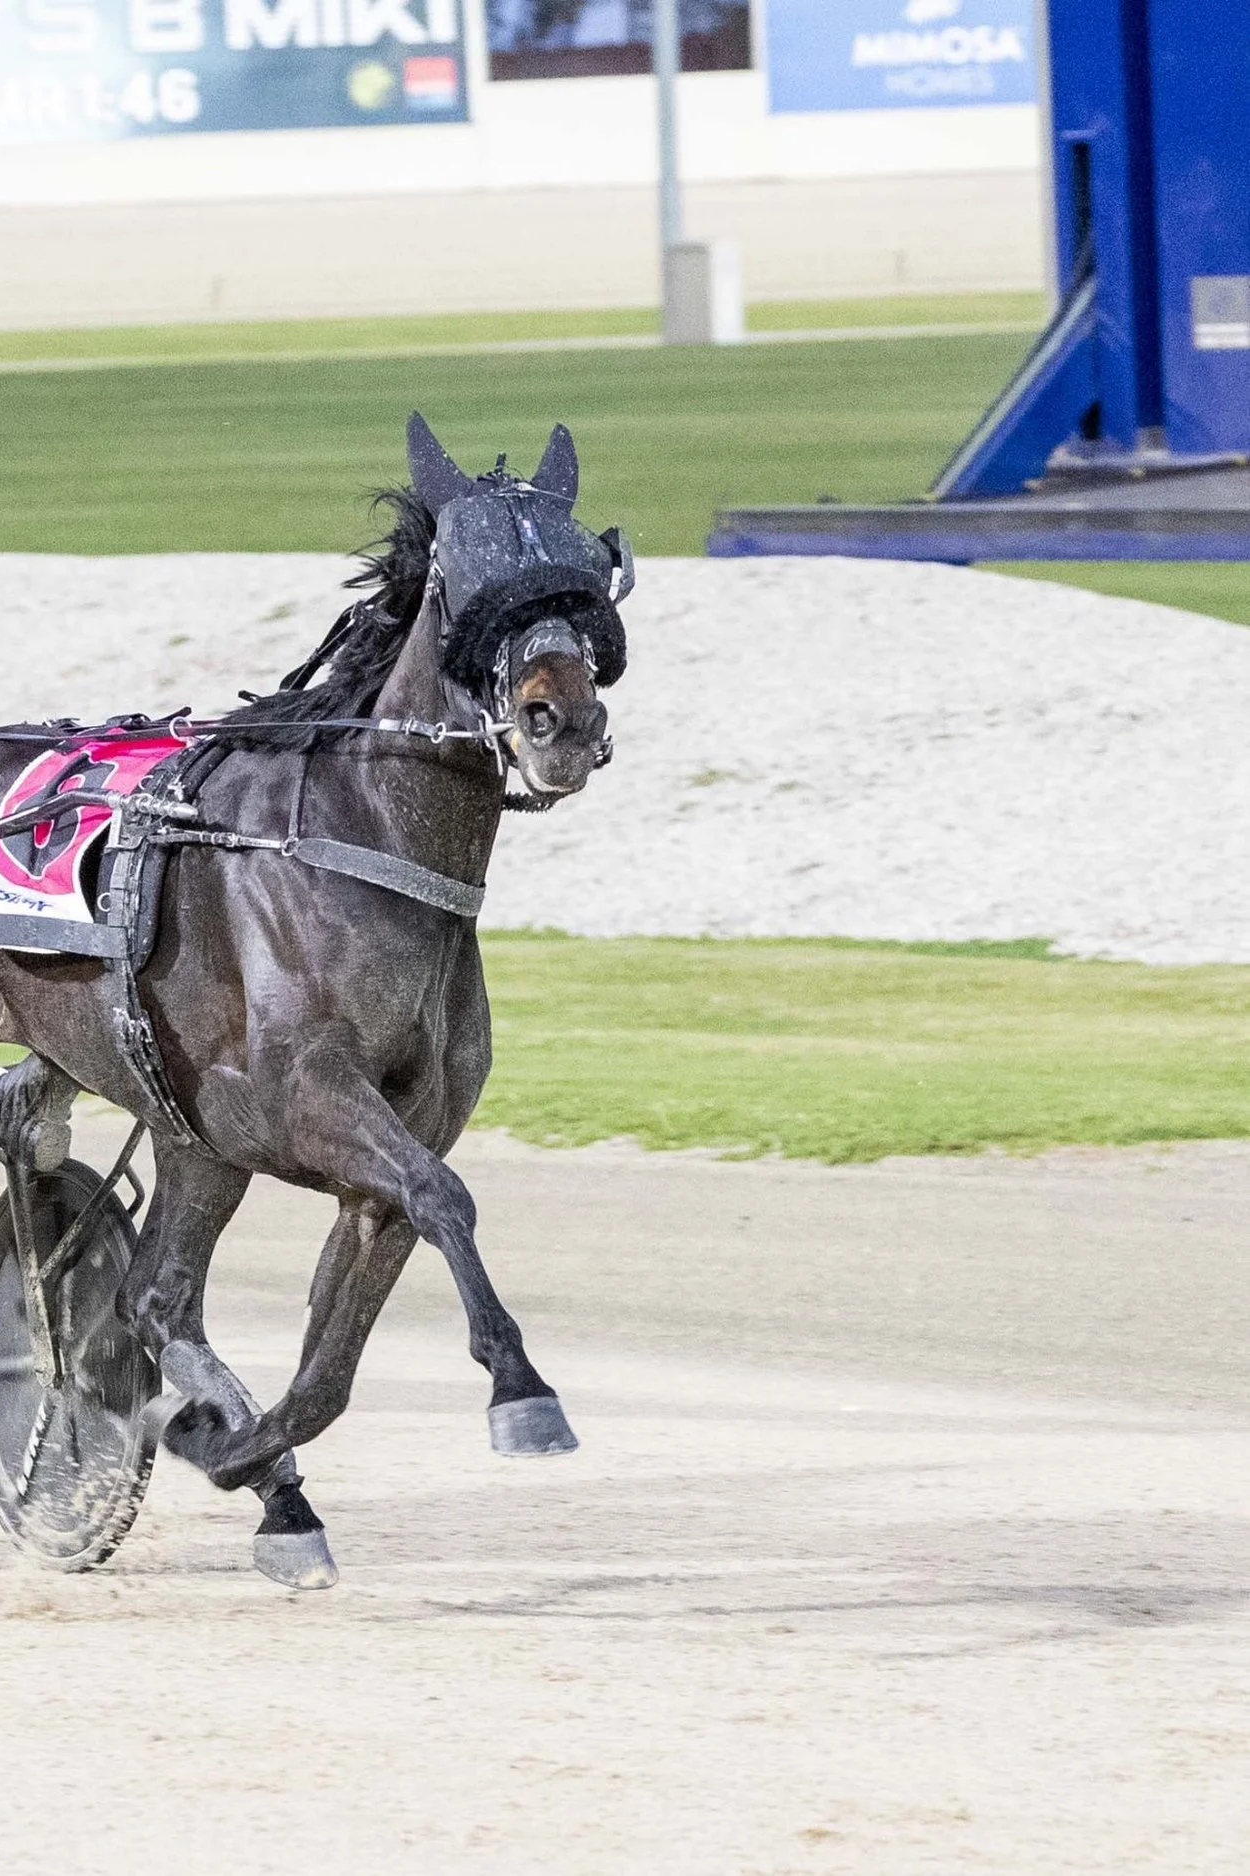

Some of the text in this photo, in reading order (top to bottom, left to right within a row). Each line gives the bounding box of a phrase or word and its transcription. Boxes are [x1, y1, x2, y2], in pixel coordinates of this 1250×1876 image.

[130, 0, 204, 51] B
[227, 0, 455, 48] MIKI
[851, 26, 1025, 67] MIMOSA
